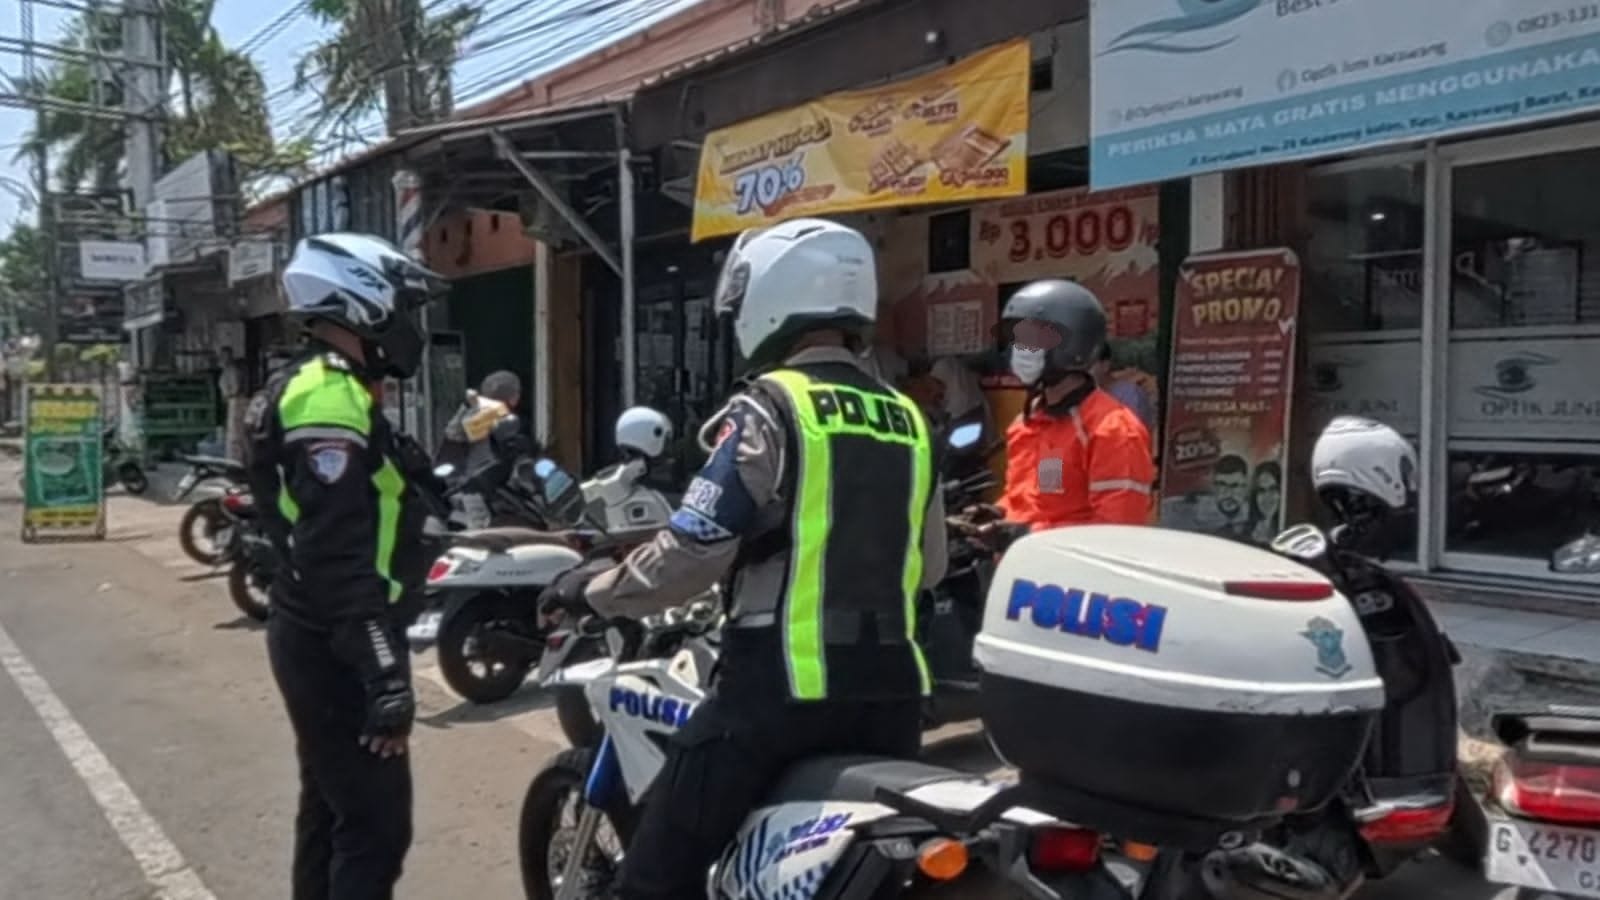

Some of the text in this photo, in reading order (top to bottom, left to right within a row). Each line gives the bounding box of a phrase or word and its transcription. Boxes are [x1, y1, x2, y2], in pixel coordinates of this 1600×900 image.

[1107, 128, 1198, 158] PERIKSA
[1204, 115, 1265, 139] MATA
[1273, 92, 1367, 127] GRATIS
[734, 152, 805, 217] 70%
[1008, 206, 1135, 264] 3.000
[1191, 297, 1282, 328] PROMO
[1006, 578, 1167, 654] POLISI
[610, 686, 691, 728] POLISI
